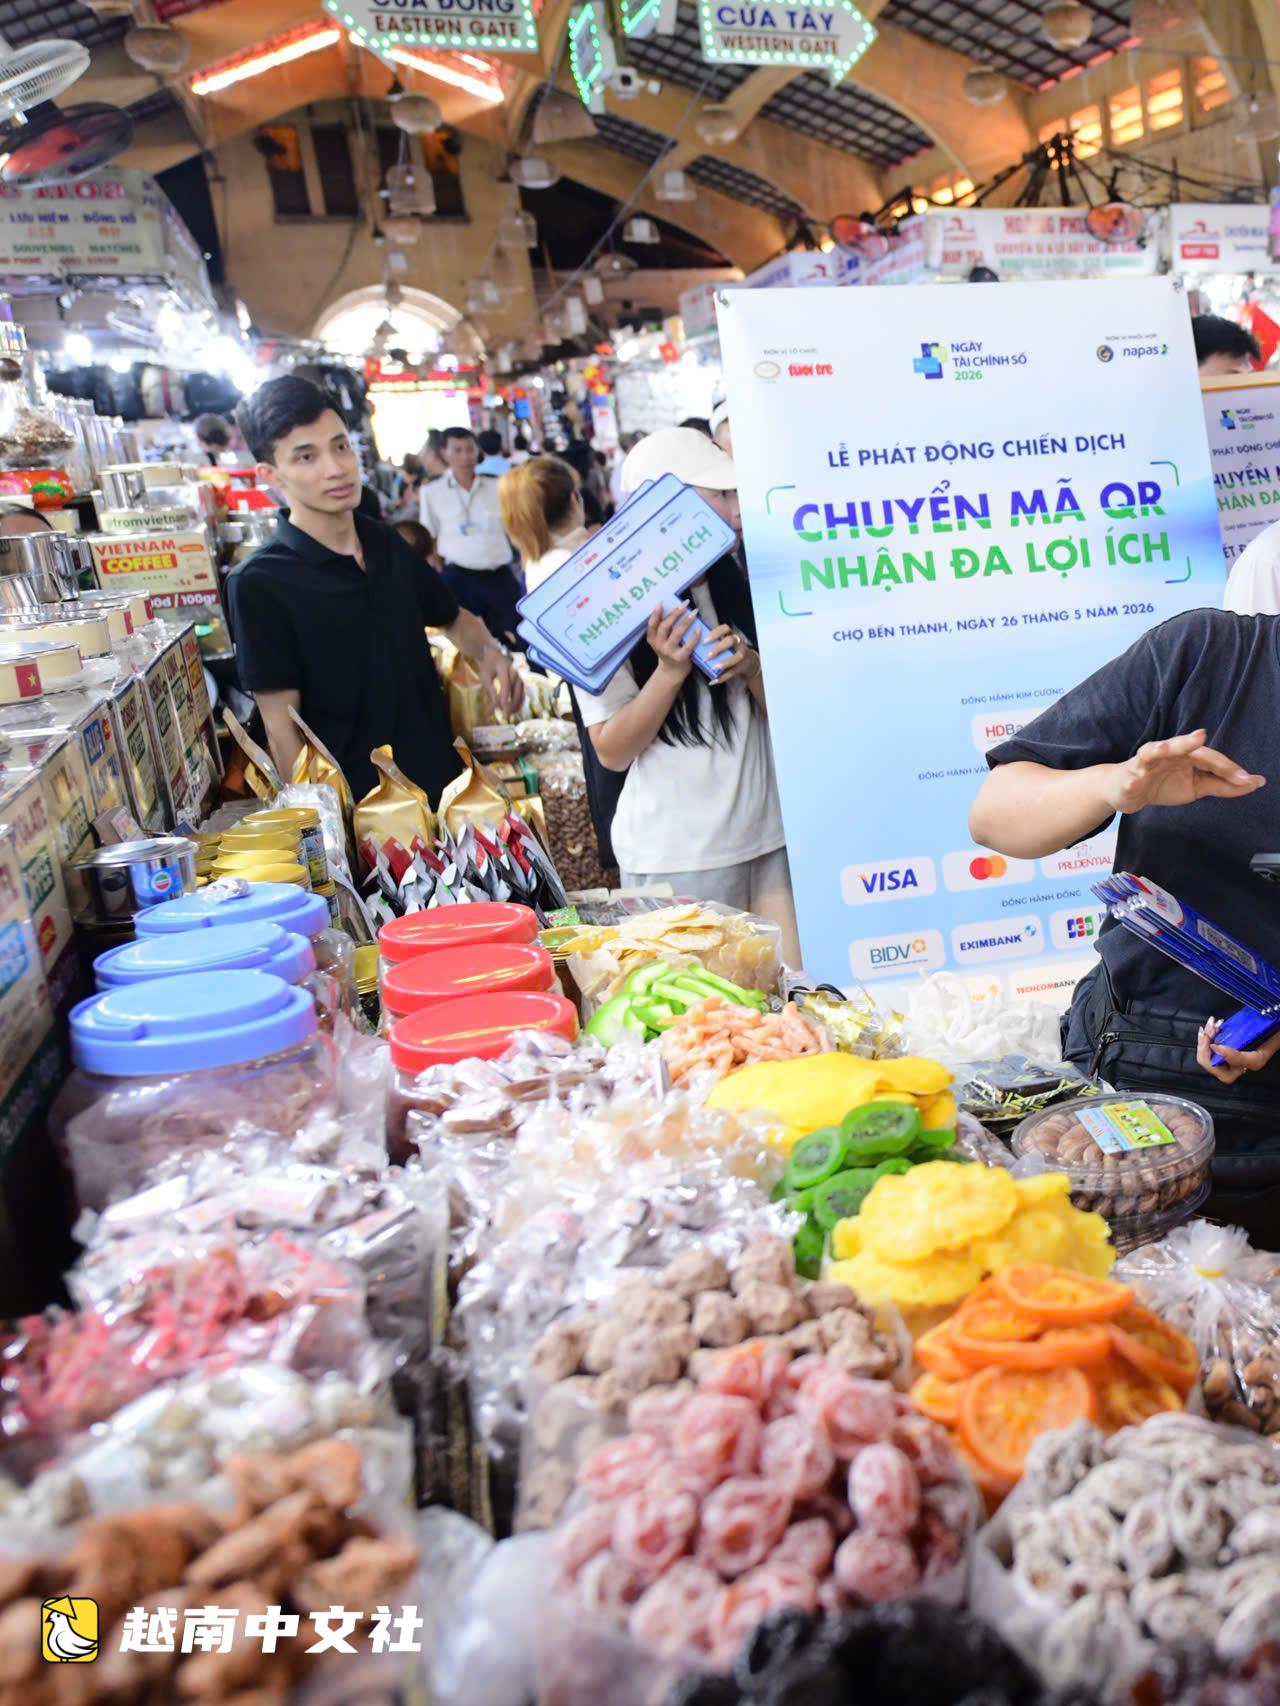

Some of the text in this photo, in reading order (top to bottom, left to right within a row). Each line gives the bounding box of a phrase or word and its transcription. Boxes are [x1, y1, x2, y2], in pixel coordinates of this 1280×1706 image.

[374, 15, 519, 38] EASTERN GATE
[721, 35, 839, 54] WESTERN GATE
[951, 340, 983, 353] NGÀY
[952, 351, 1028, 367] TÀI CHÍNH SỐ
[954, 370, 983, 381] 2026
[828, 432, 1126, 469] LỄ PHÁT ĐỘNG CHIẾN DỊCH
[1214, 461, 1269, 490] HUYỂN
[793, 478, 1165, 543] CHUYỂN MÃ QR
[1217, 492, 1256, 512] HẬN
[95, 538, 177, 556] VIETNAM
[106, 553, 174, 573] COFFEE
[800, 526, 1171, 593] NHẬN ĐA LỢI ÍCH
[579, 597, 632, 646] NHẬN
[629, 576, 657, 601] ĐA
[654, 550, 684, 578] LỢI
[681, 526, 713, 554] ÍCH
[180, 593, 217, 607] 100gr
[833, 602, 1155, 643] CHỢ BẾN THÀNH, NGÀY 26 THÁNG 5 NĂM 2026
[960, 695, 987, 705] ĐỒNG
[989, 692, 1014, 702] HÀNH
[1016, 690, 1032, 699] KIM
[985, 723, 1025, 738] HDBa
[1058, 856, 1112, 871] PRUDENTIAL
[857, 868, 919, 894] VISA
[1029, 892, 1054, 903] HÀNH
[959, 933, 1022, 951] EXIMBANK
[870, 943, 911, 964] BIDV
[1016, 978, 1076, 995] TECHCOMBANK
